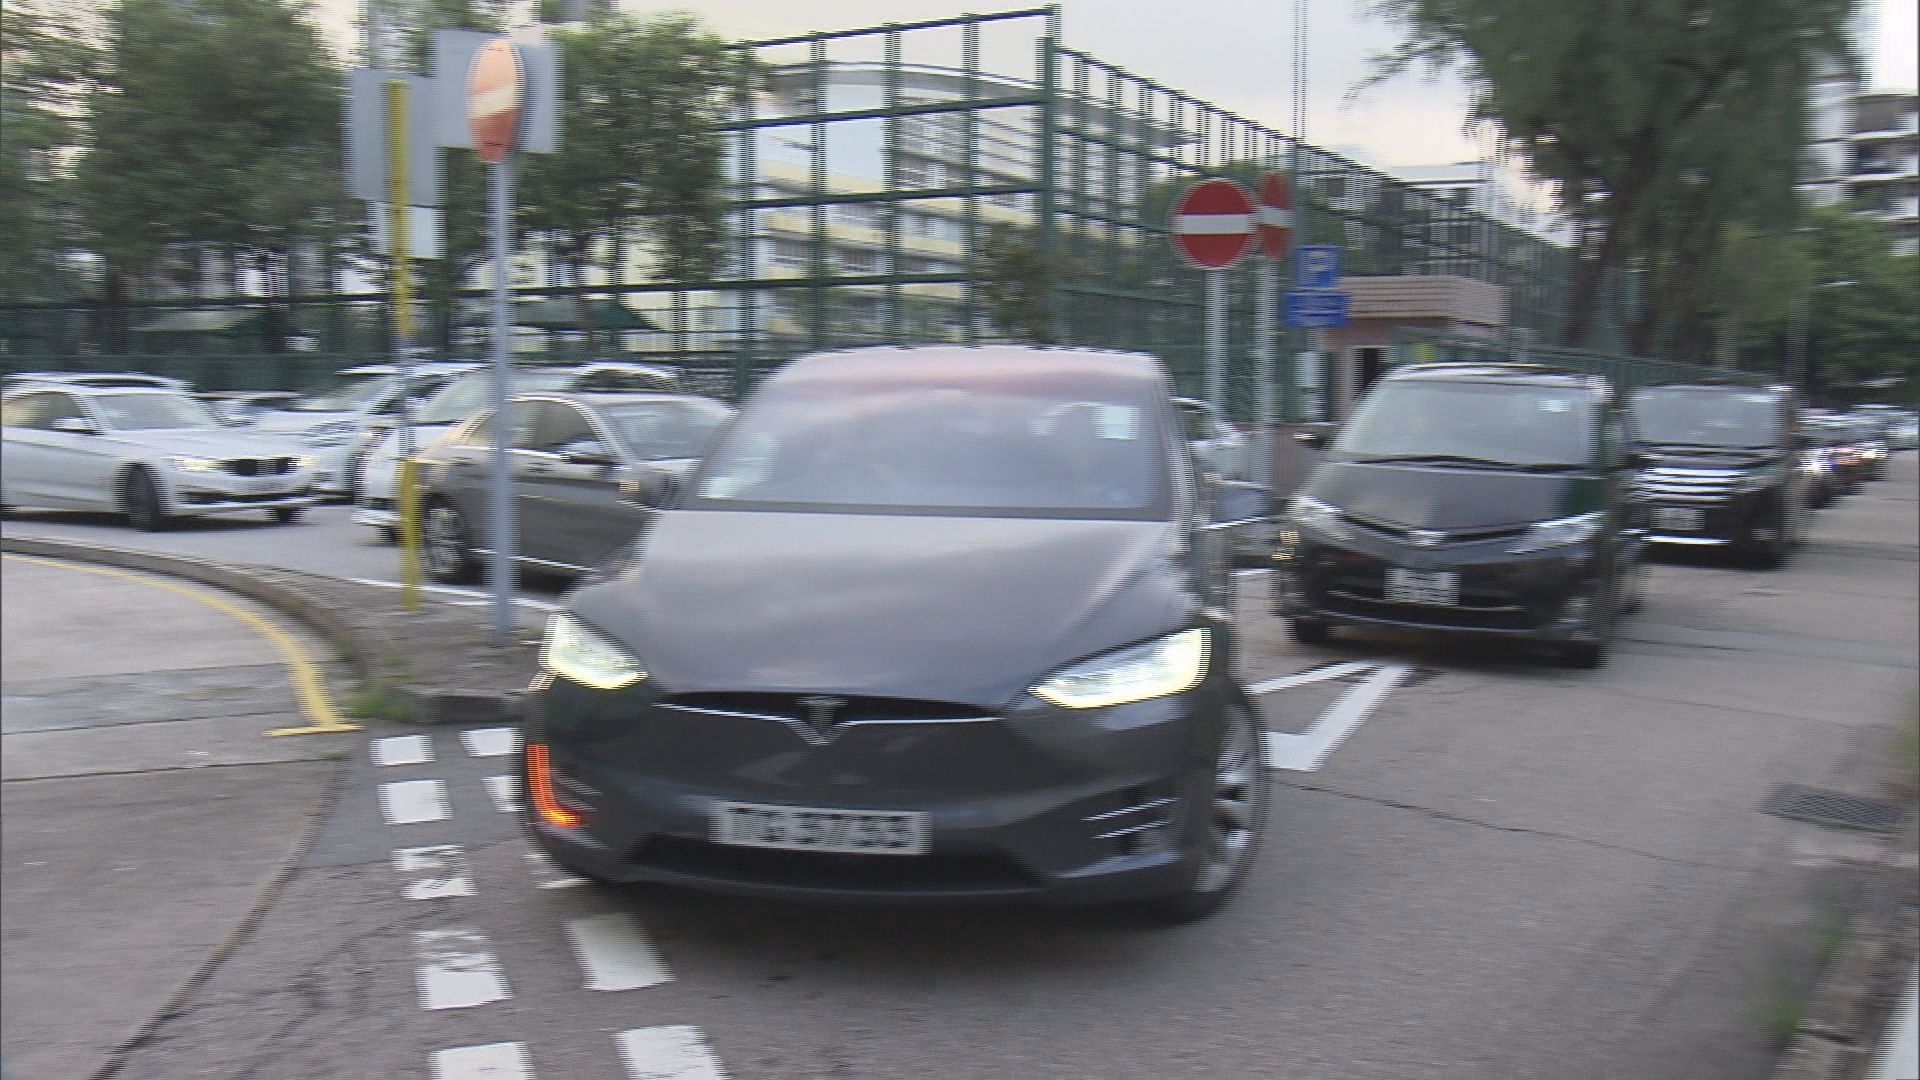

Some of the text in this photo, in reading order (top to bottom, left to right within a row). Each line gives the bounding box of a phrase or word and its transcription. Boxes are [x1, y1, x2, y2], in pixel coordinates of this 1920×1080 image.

[1303, 250, 1336, 285] P
[727, 807, 913, 849] TG 3733
